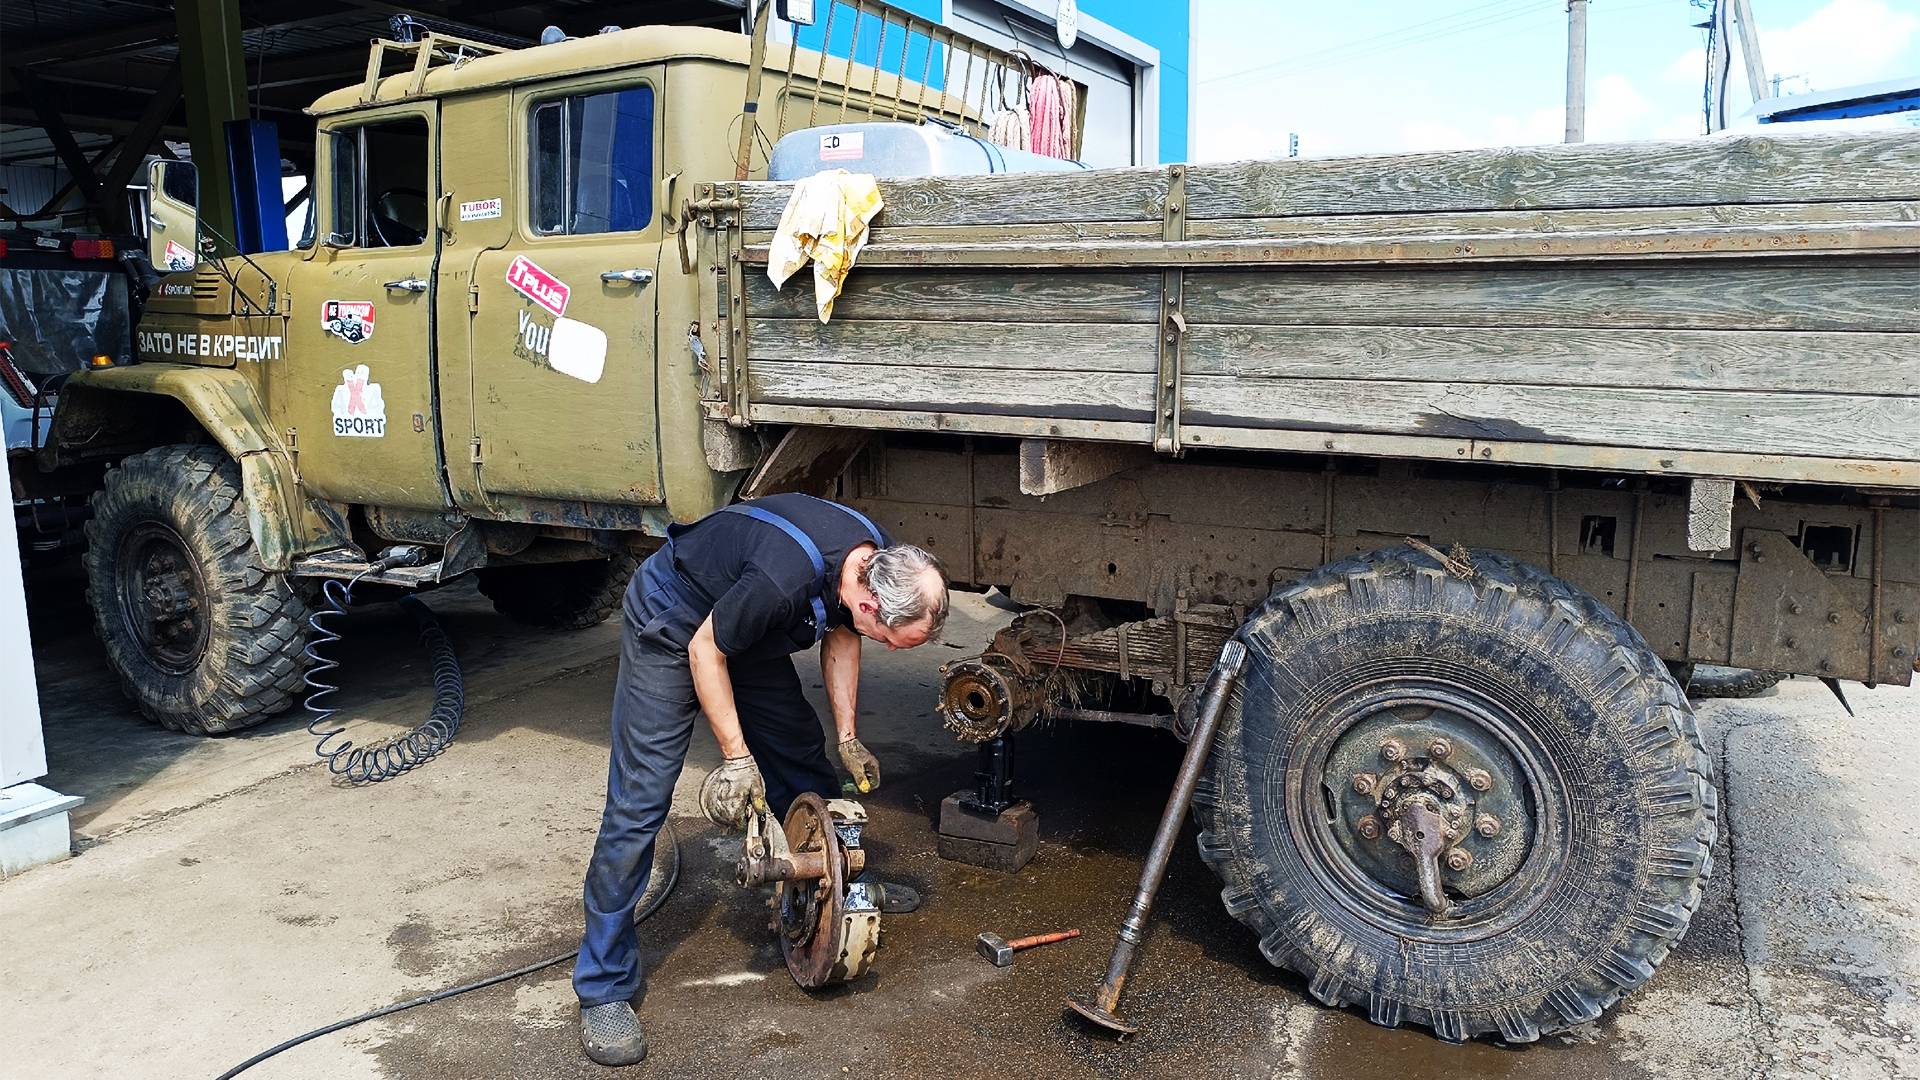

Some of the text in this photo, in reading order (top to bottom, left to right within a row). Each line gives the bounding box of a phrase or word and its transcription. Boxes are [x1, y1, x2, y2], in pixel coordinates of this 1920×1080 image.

[462, 201, 496, 212] TUBOR
[519, 309, 550, 356] You
[138, 331, 282, 362] ЗАТО НЕ В КРЕДИТ
[335, 417, 383, 434] SPORT
